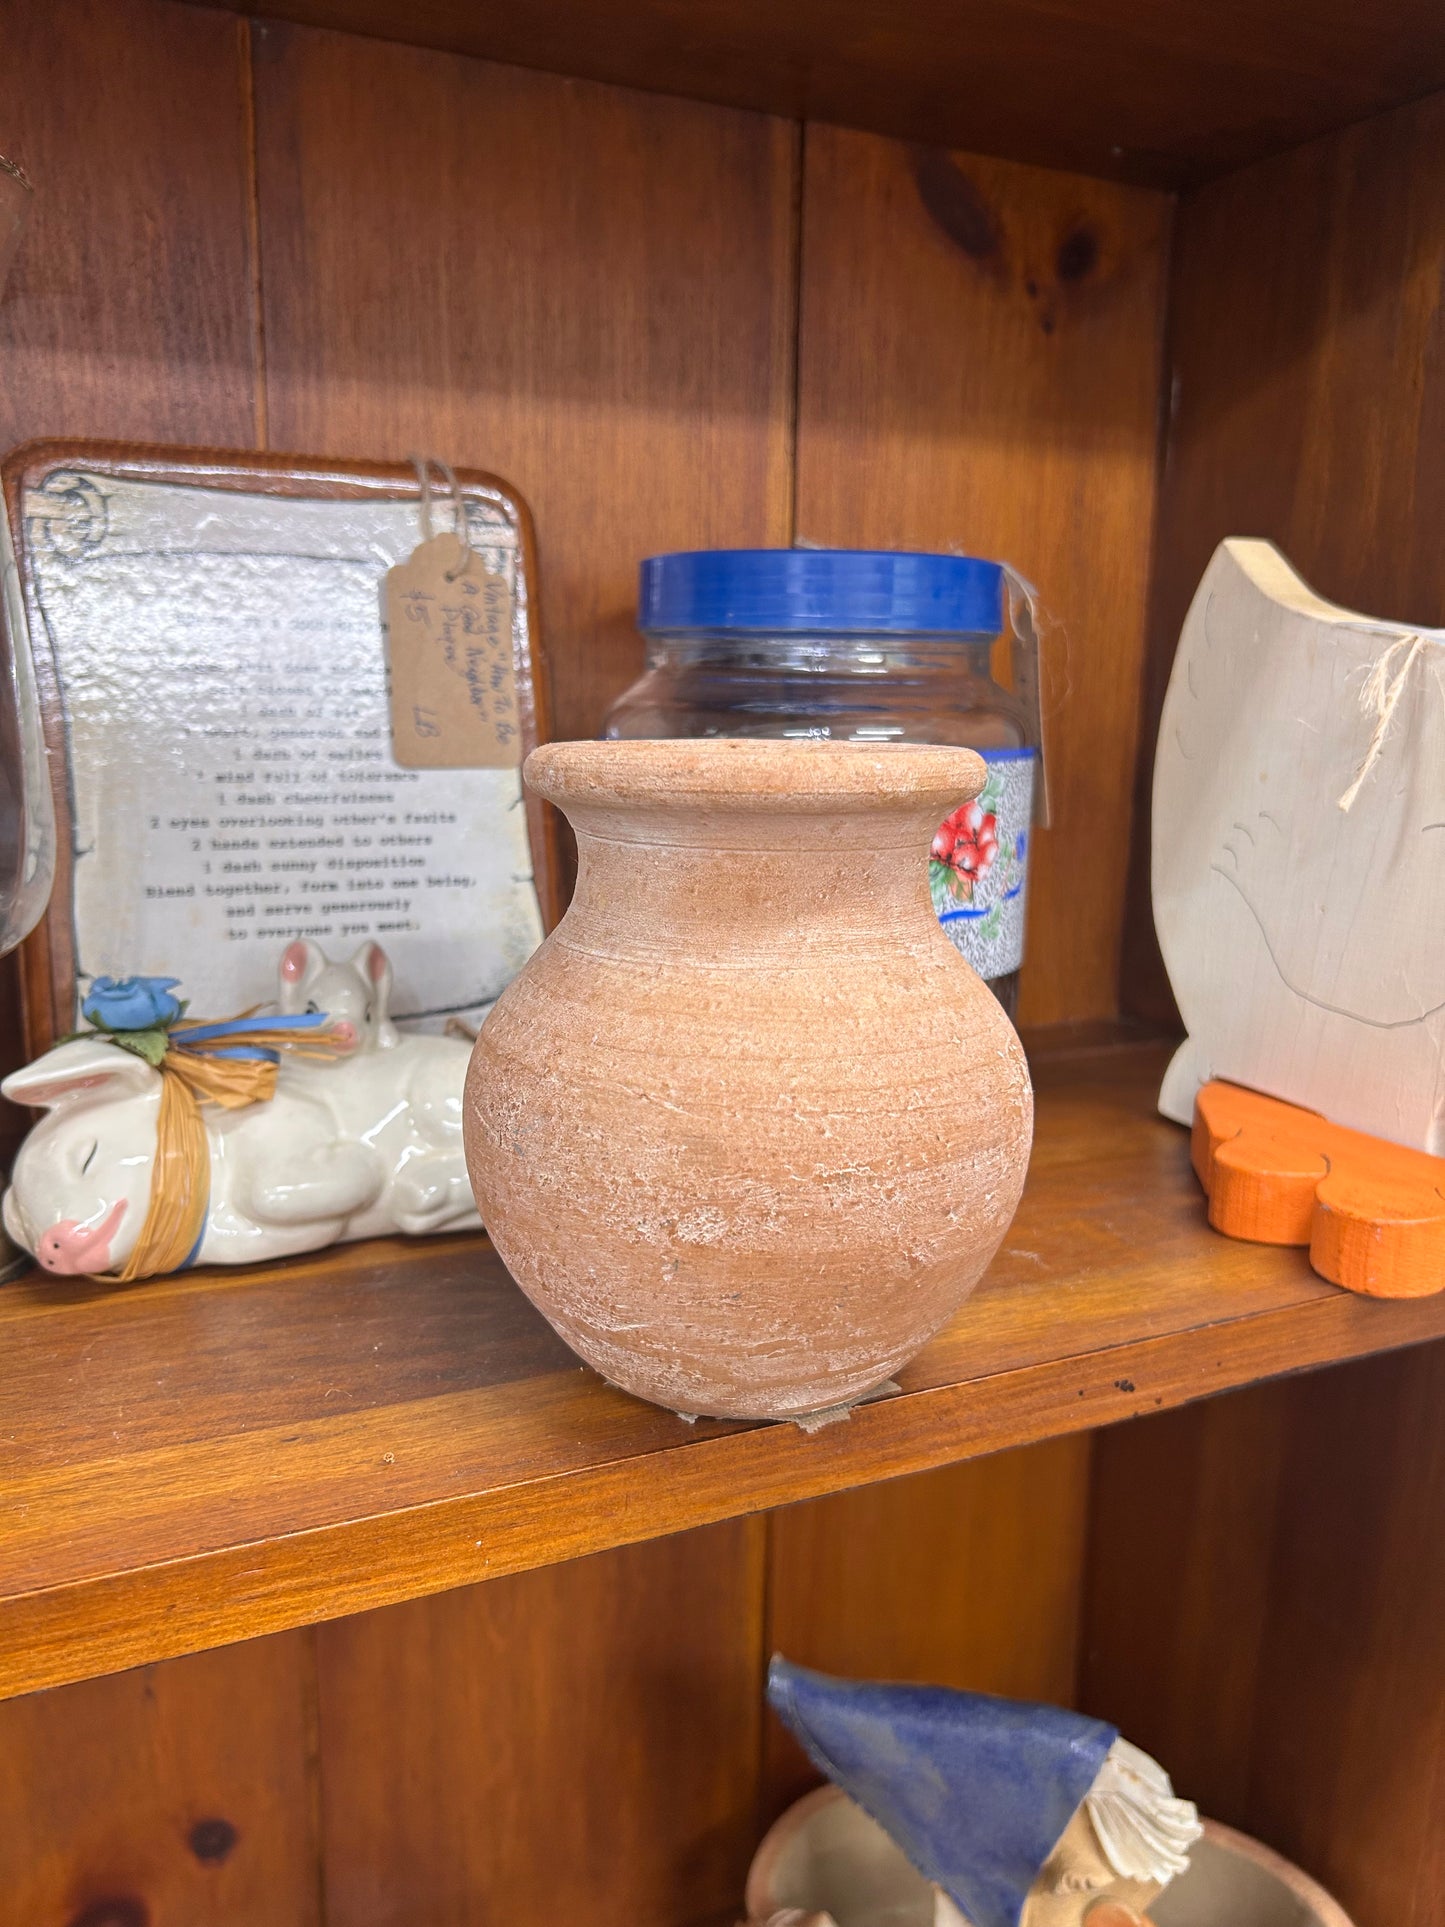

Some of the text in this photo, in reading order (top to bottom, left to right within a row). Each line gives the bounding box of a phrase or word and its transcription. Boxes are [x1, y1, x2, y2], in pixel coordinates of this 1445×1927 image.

[237, 793, 275, 805] dash
[285, 793, 395, 805] cheerfulness
[150, 811, 457, 831] 2 eyes overlooking other's faults
[191, 833, 433, 852] 2 hands extended to others
[223, 860, 261, 873] dash
[271, 859, 317, 873] sunny
[327, 856, 426, 871] disposition
[205, 881, 290, 897] together,
[302, 880, 338, 893] form
[349, 878, 384, 891] into
[391, 879, 419, 890] one
[226, 899, 411, 918] and serve generously
[229, 929, 247, 941] to
[256, 924, 332, 939] everyone
[341, 924, 369, 937] you
